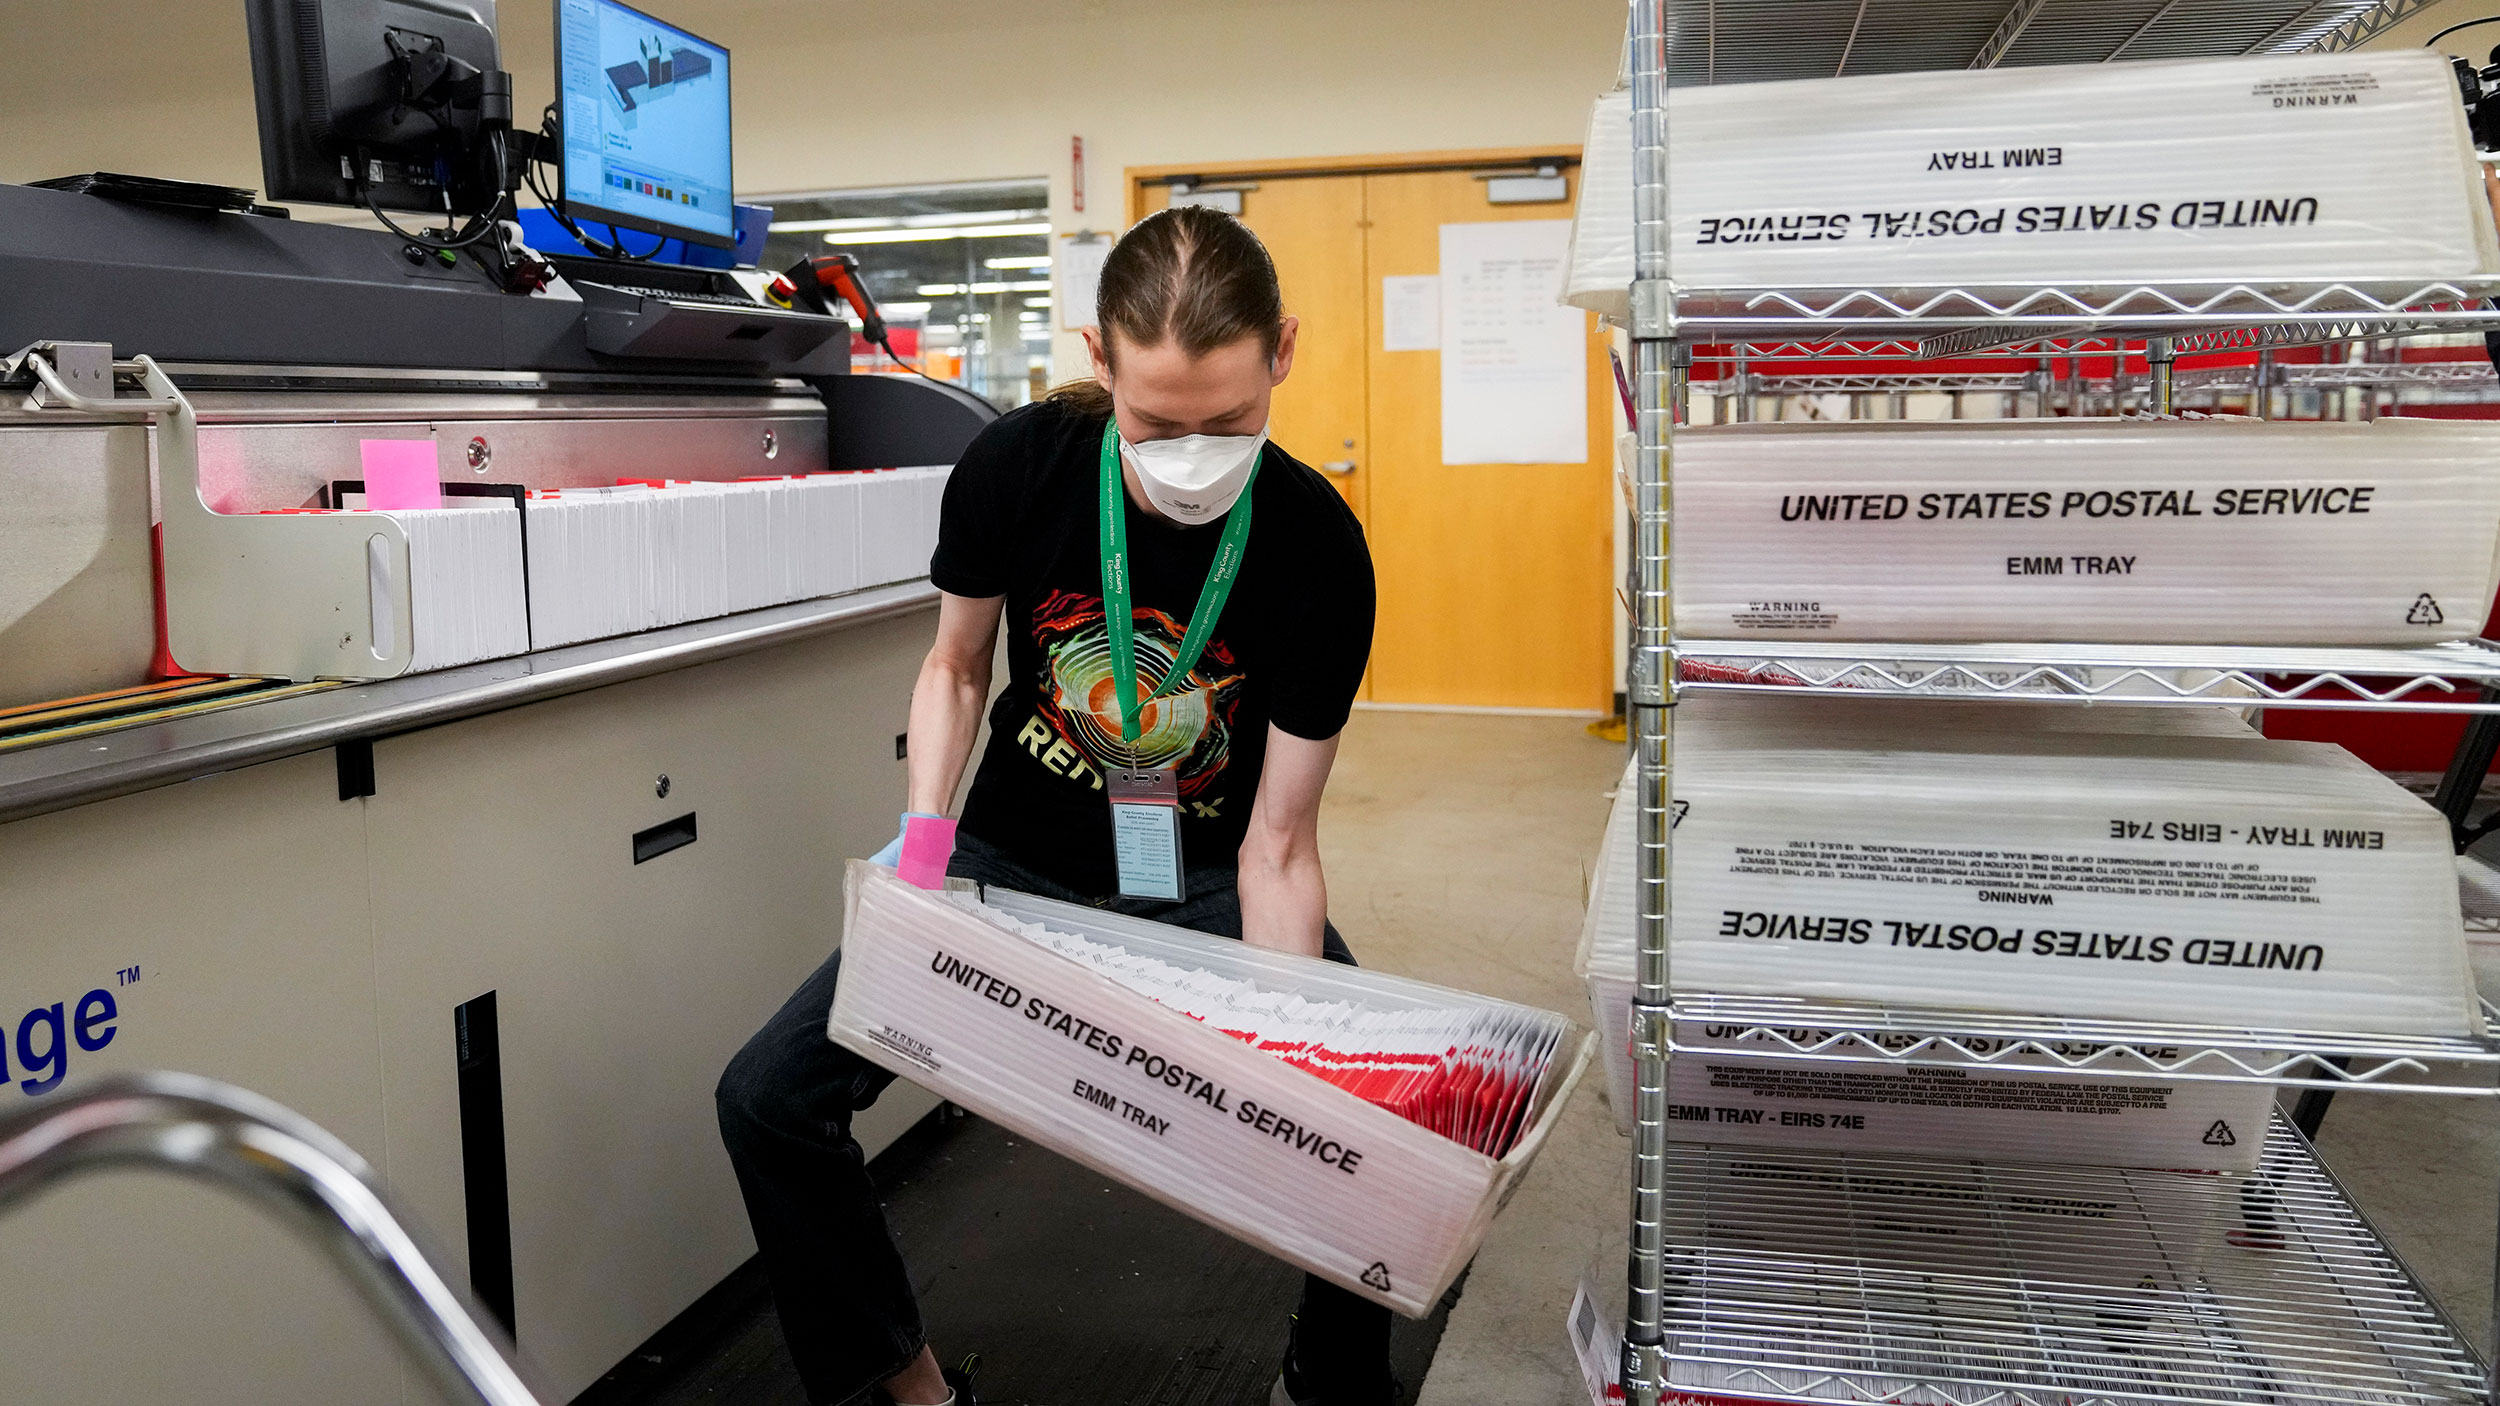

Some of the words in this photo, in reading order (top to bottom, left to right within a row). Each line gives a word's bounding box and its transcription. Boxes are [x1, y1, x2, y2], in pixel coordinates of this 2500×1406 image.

[2274, 95, 2356, 108] WARNING
[1928, 152, 1994, 170] TRAY
[2004, 148, 2061, 167] EMM
[1863, 209, 2005, 237] POSTAL
[2016, 204, 2160, 232] STATES
[2172, 198, 2317, 227] UNITED
[1697, 214, 1850, 244] SERVICE
[1781, 495, 1908, 521] UNITED
[1918, 492, 2051, 519] STATES
[2061, 490, 2201, 517] POSTAL
[2213, 488, 2374, 515] SERVICE
[1213, 564, 1225, 583] King
[1219, 541, 1234, 567] County
[1223, 549, 1239, 580] Elections
[2008, 557, 2062, 574] EMM
[2071, 557, 2135, 574] TRAY
[1115, 569, 1123, 595] County
[1750, 602, 1819, 611] WARNING
[2111, 821, 2154, 839] 74E
[2163, 823, 2221, 842] EIRS
[2247, 827, 2314, 846] TRAY
[2324, 830, 2383, 849] EMM
[1979, 891, 2052, 905] WARNING
[1720, 911, 1872, 944] SERVICE
[1884, 921, 2023, 953] POSTAL
[2032, 930, 2173, 962] STATES
[2183, 939, 2323, 971] UNITED
[884, 1025, 933, 1056] WARNING
[932, 951, 1021, 1008] UNITED
[1025, 998, 1122, 1057] STATES
[1128, 1046, 1229, 1114] POSTAL
[1237, 1101, 1362, 1174] SERVICE
[1906, 1067, 1967, 1079] WARNING
[1073, 1079, 1116, 1111] EMM
[1123, 1101, 1170, 1135] TRAY
[1668, 1105, 1709, 1121] EMM
[1715, 1108, 1764, 1124] TRAY
[1781, 1112, 1825, 1127] EIRS
[1830, 1115, 1864, 1129] 74E
